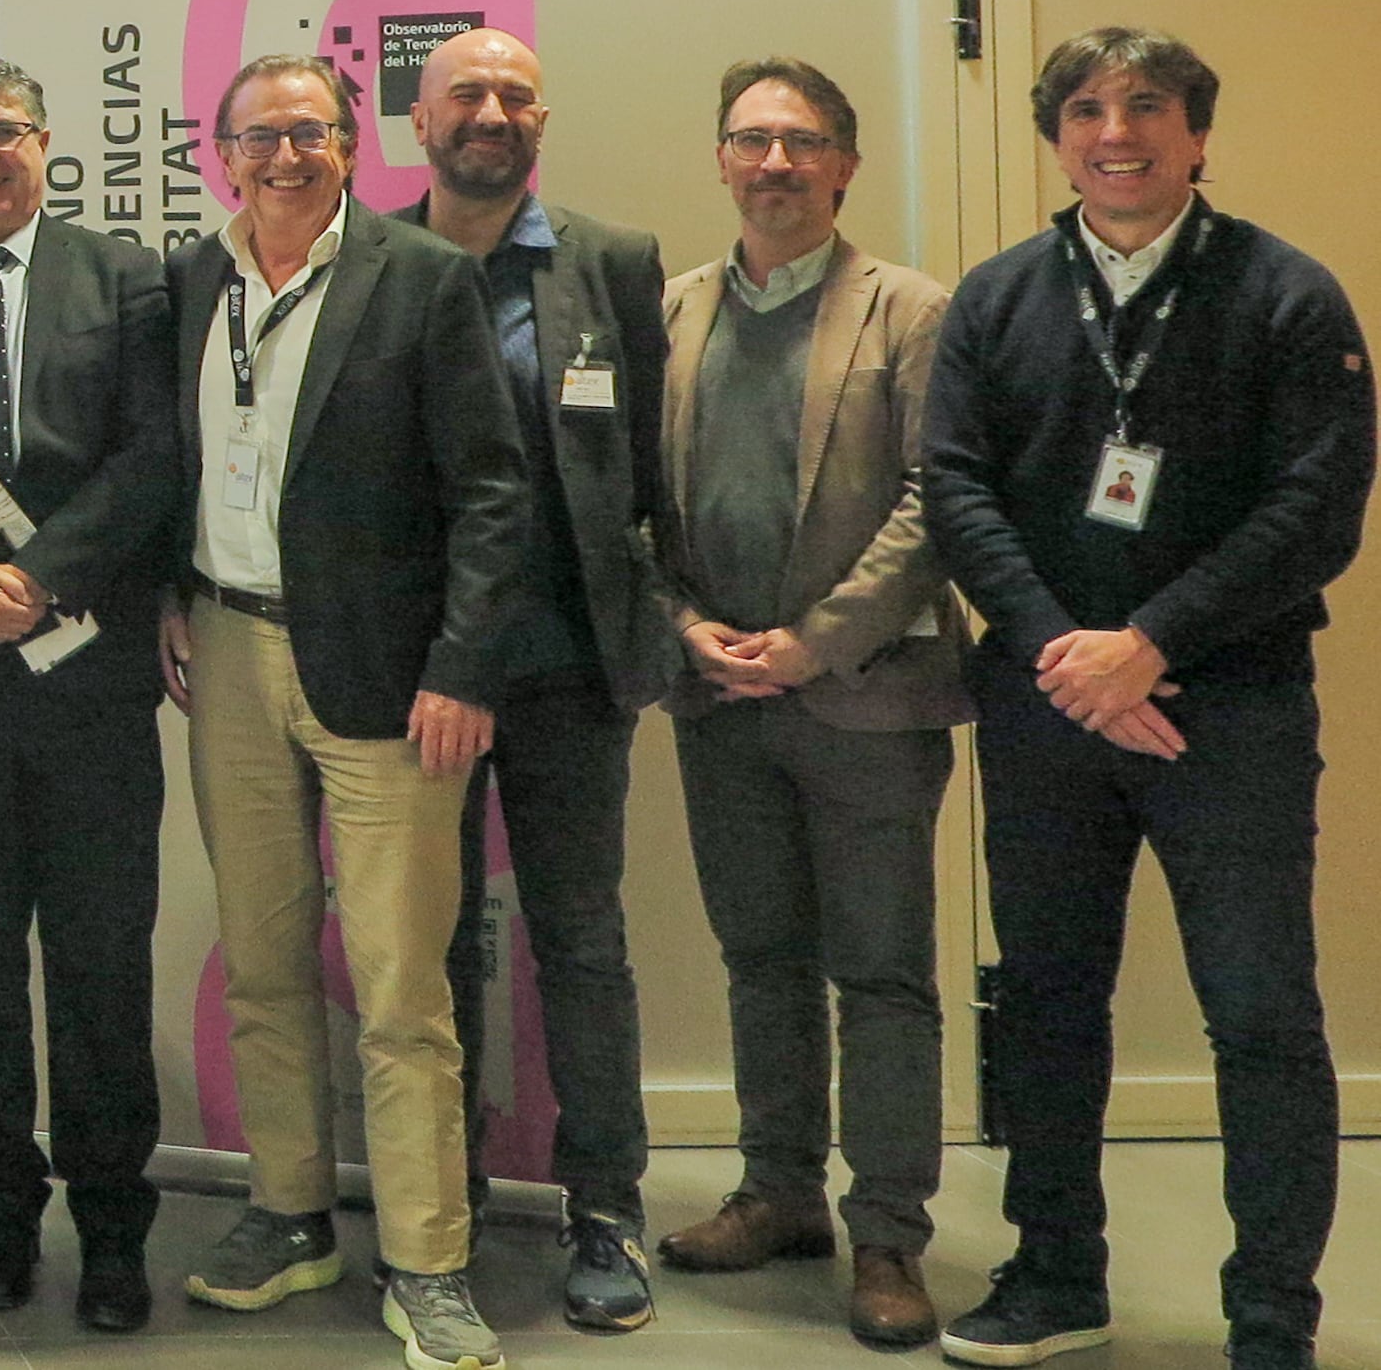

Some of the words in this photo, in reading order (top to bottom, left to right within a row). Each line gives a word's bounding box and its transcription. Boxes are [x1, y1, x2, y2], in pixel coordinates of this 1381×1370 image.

[383, 20, 471, 36] Observatorio
[383, 39, 401, 52] de
[383, 55, 405, 68] del
